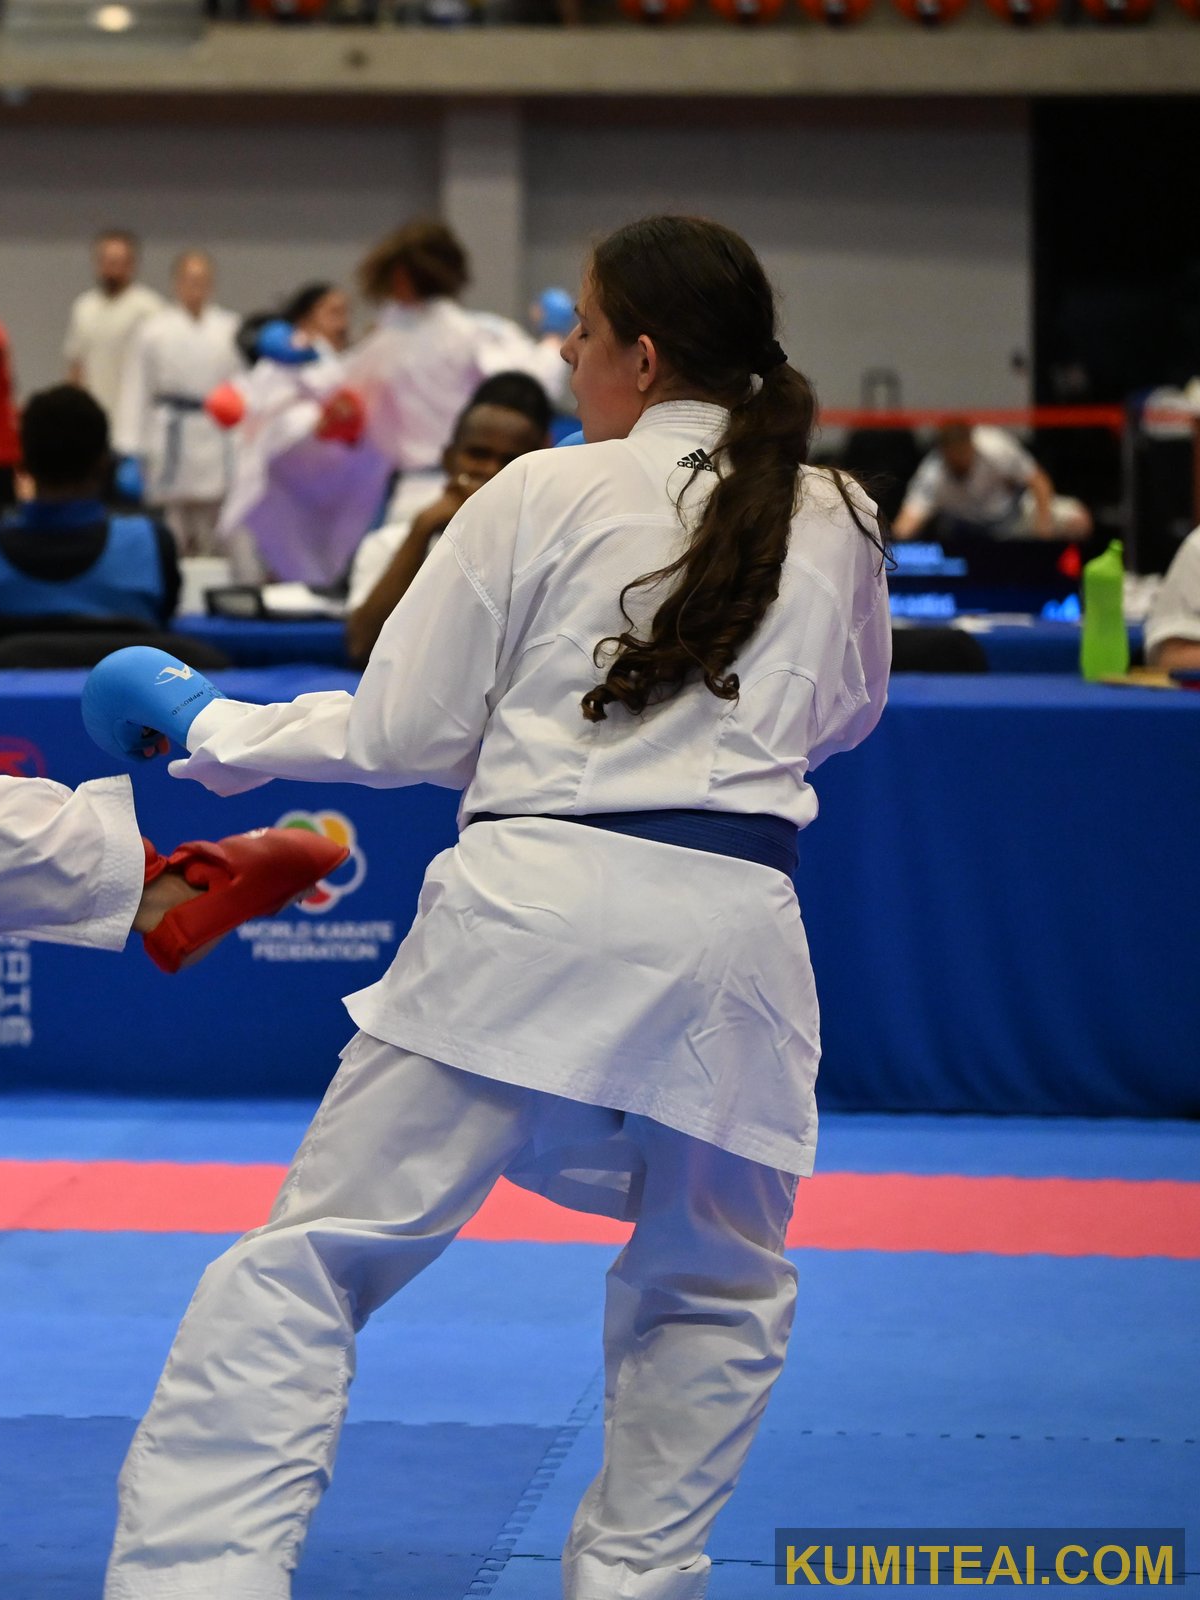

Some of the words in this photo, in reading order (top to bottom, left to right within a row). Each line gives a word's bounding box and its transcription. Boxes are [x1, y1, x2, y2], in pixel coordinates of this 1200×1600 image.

[677, 461, 716, 472] adida
[238, 921, 312, 940] WORLD
[315, 921, 394, 942] KARATE
[253, 943, 378, 961] FEDERATION
